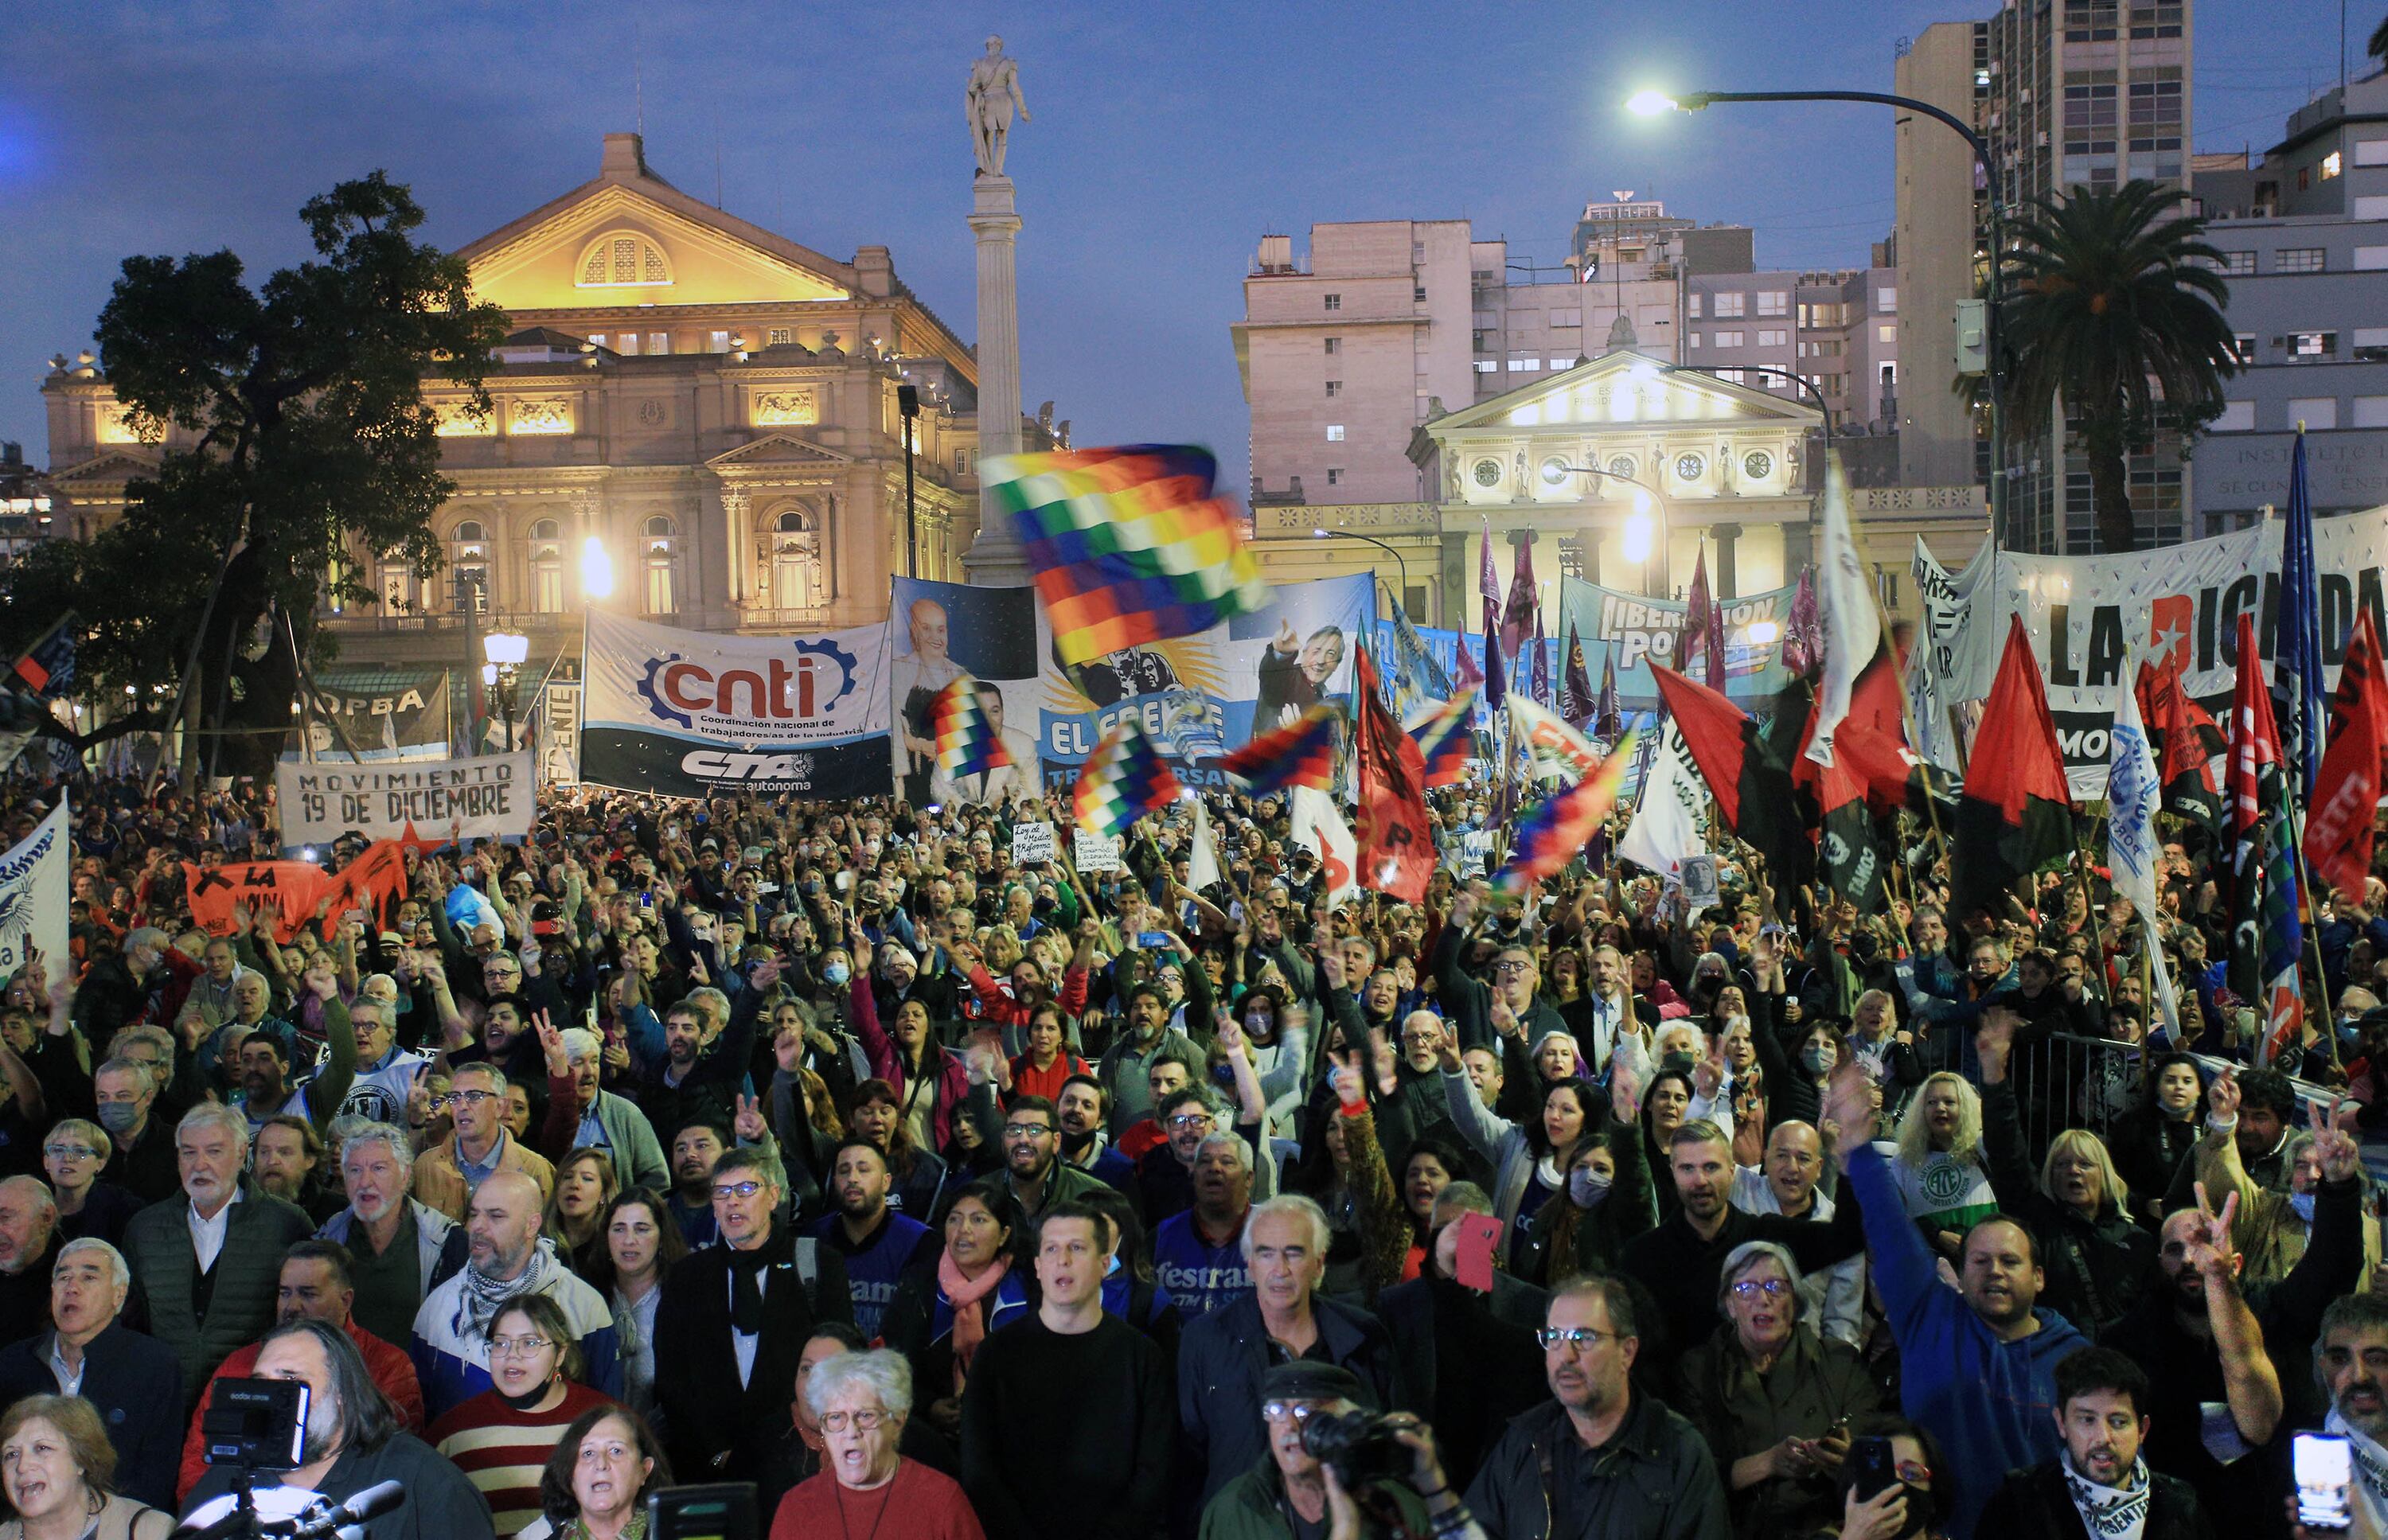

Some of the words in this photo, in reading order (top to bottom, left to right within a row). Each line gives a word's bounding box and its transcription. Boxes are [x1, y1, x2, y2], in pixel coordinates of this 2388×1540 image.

[2238, 444, 2367, 463] INSTTUTO
[1600, 595, 1775, 641] LIBERIÓN
[2050, 604, 2124, 687] LA
[2151, 566, 2388, 678] DIGNDA
[664, 657, 815, 719] cnti
[548, 688, 573, 782] FENTE
[700, 715, 771, 729] Coordinación
[774, 719, 819, 730] nacional
[821, 719, 835, 727] de
[1051, 720, 1091, 755] EL
[1098, 700, 1224, 745] FREE
[298, 762, 513, 791] MOVIMIENTO
[681, 749, 798, 780] CTA
[302, 793, 326, 823] 19
[341, 793, 372, 824] DE
[387, 782, 512, 823] DICIEMBRE
